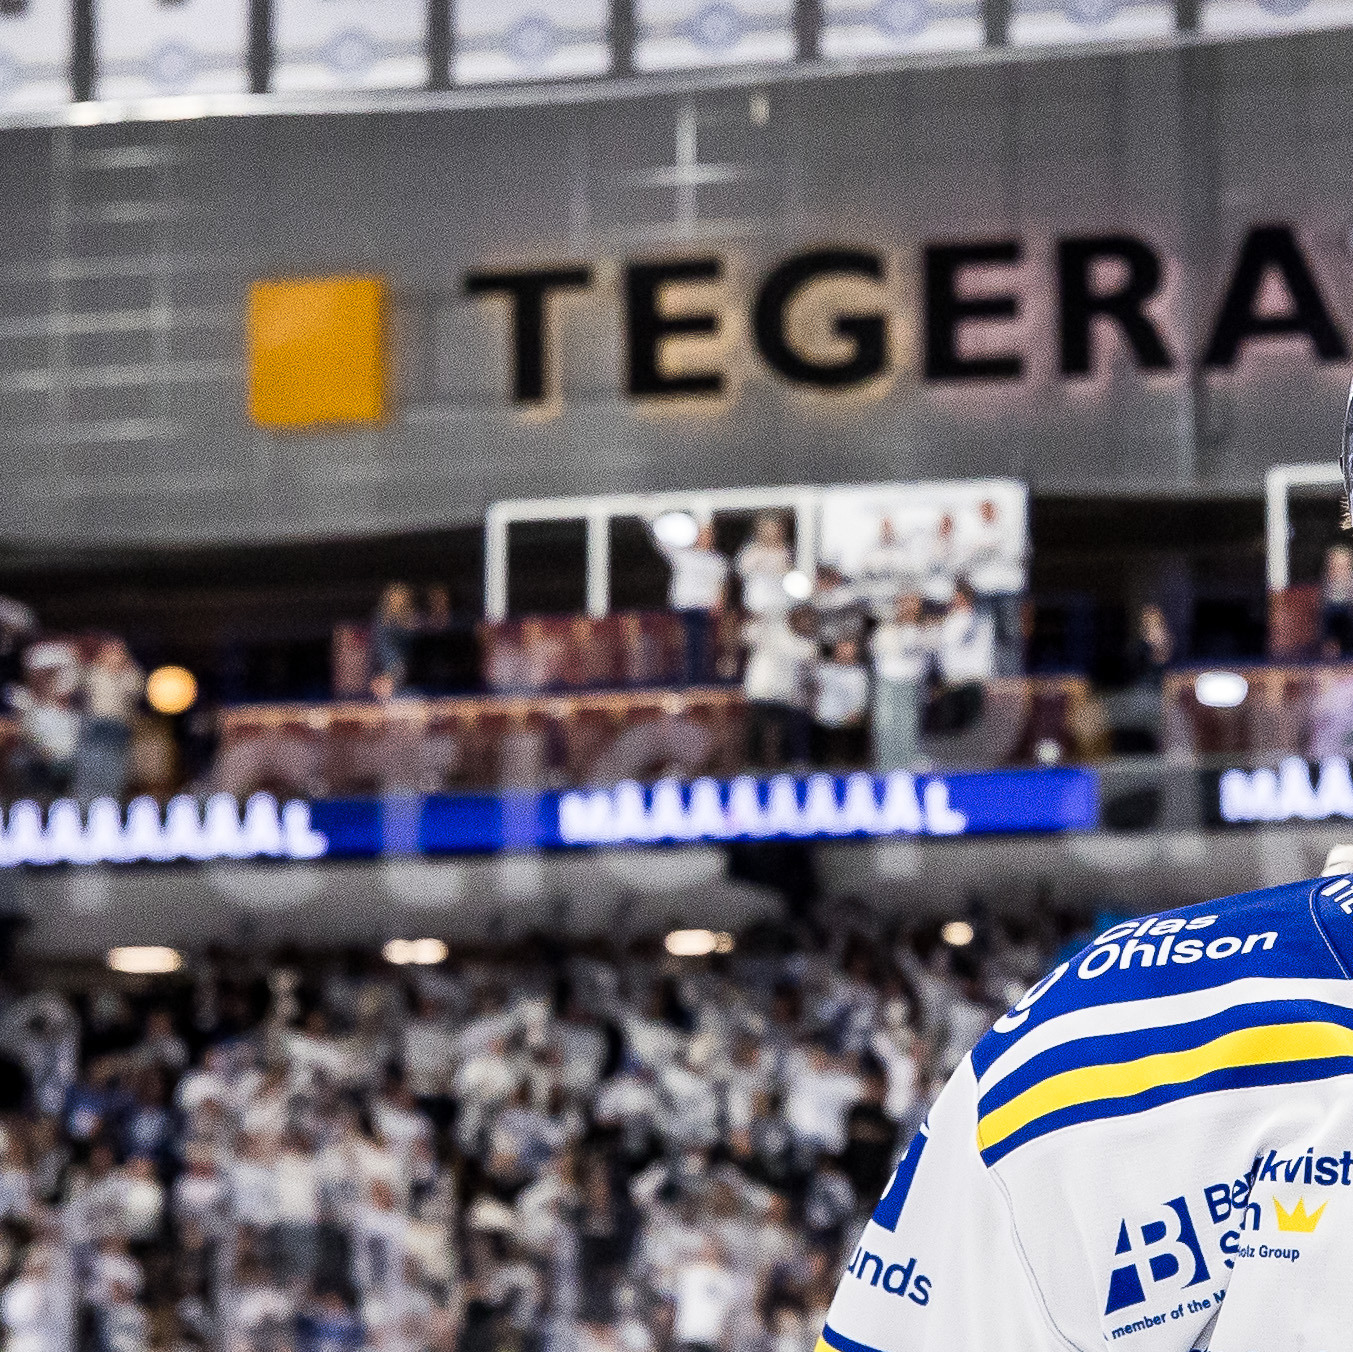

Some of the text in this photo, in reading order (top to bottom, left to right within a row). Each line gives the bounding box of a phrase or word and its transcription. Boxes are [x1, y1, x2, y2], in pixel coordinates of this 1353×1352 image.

[466, 222, 1352, 404] TEGERA
[1093, 915, 1219, 945] Clas
[1077, 931, 1279, 980] Ohlson
[1258, 1244, 1300, 1263] Group
[1111, 1310, 1168, 1341] member
[1171, 1304, 1185, 1321] of
[1187, 1297, 1212, 1316] the
